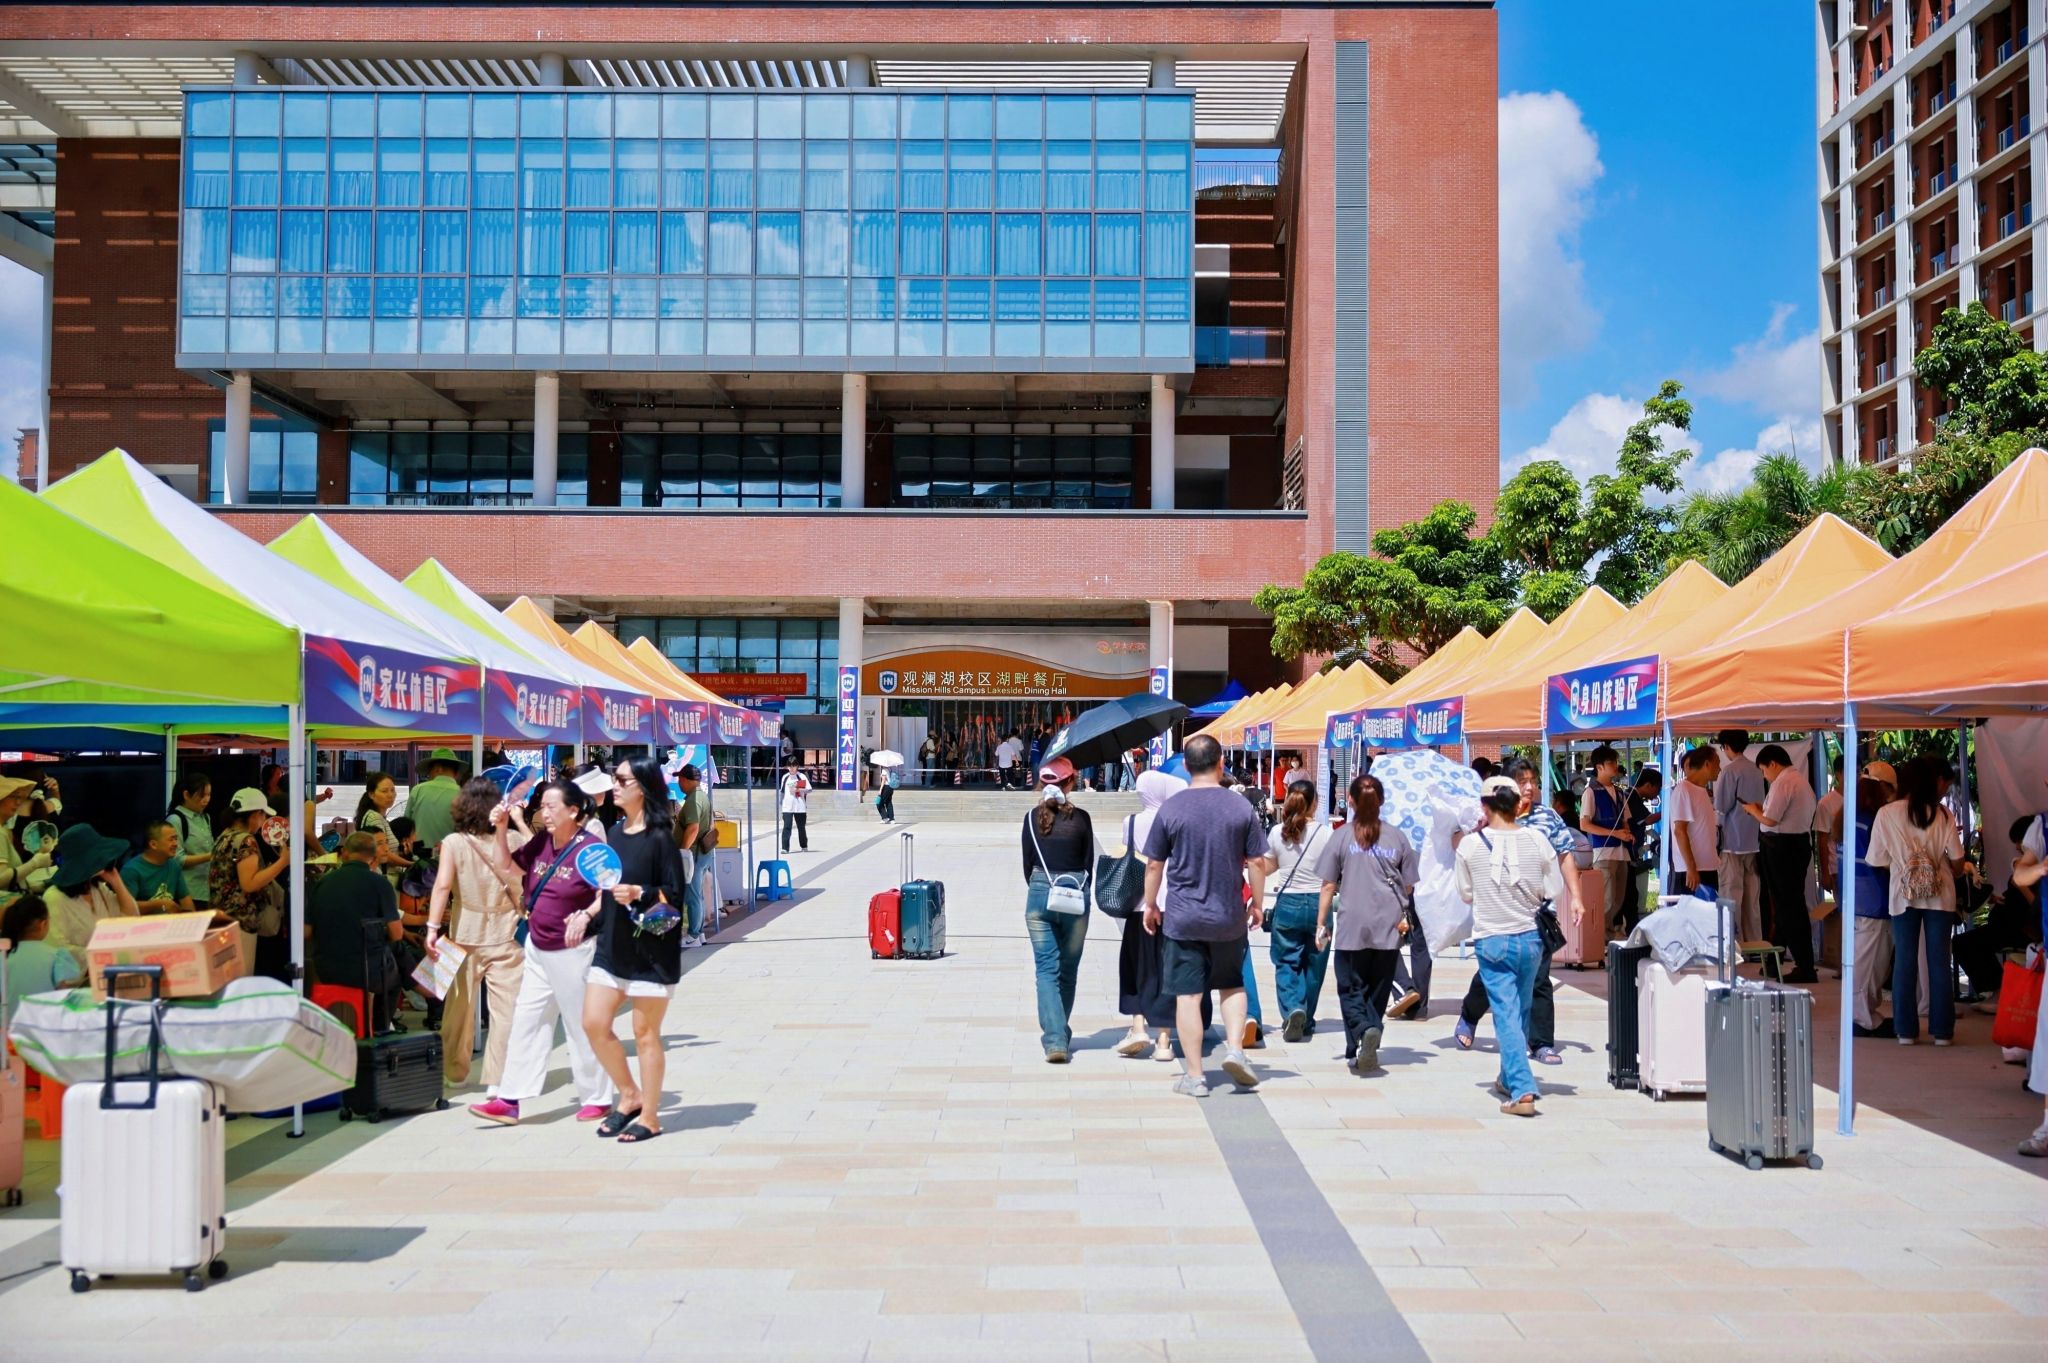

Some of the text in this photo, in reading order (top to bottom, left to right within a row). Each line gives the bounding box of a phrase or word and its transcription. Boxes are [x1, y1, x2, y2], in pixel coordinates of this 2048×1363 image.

[379, 668, 448, 715] 家长休息区
[903, 671, 1067, 687] 观澜湖校区湖畔餐厅
[952, 687, 986, 695] Campus
[1024, 687, 1050, 696] Dining
[1051, 687, 1067, 695] Hall
[1581, 676, 1638, 716] 身份核验区
[529, 692, 568, 728] 家长休息区
[612, 702, 639, 731] 家长休息区
[841, 699, 854, 783] 迎新大本营
